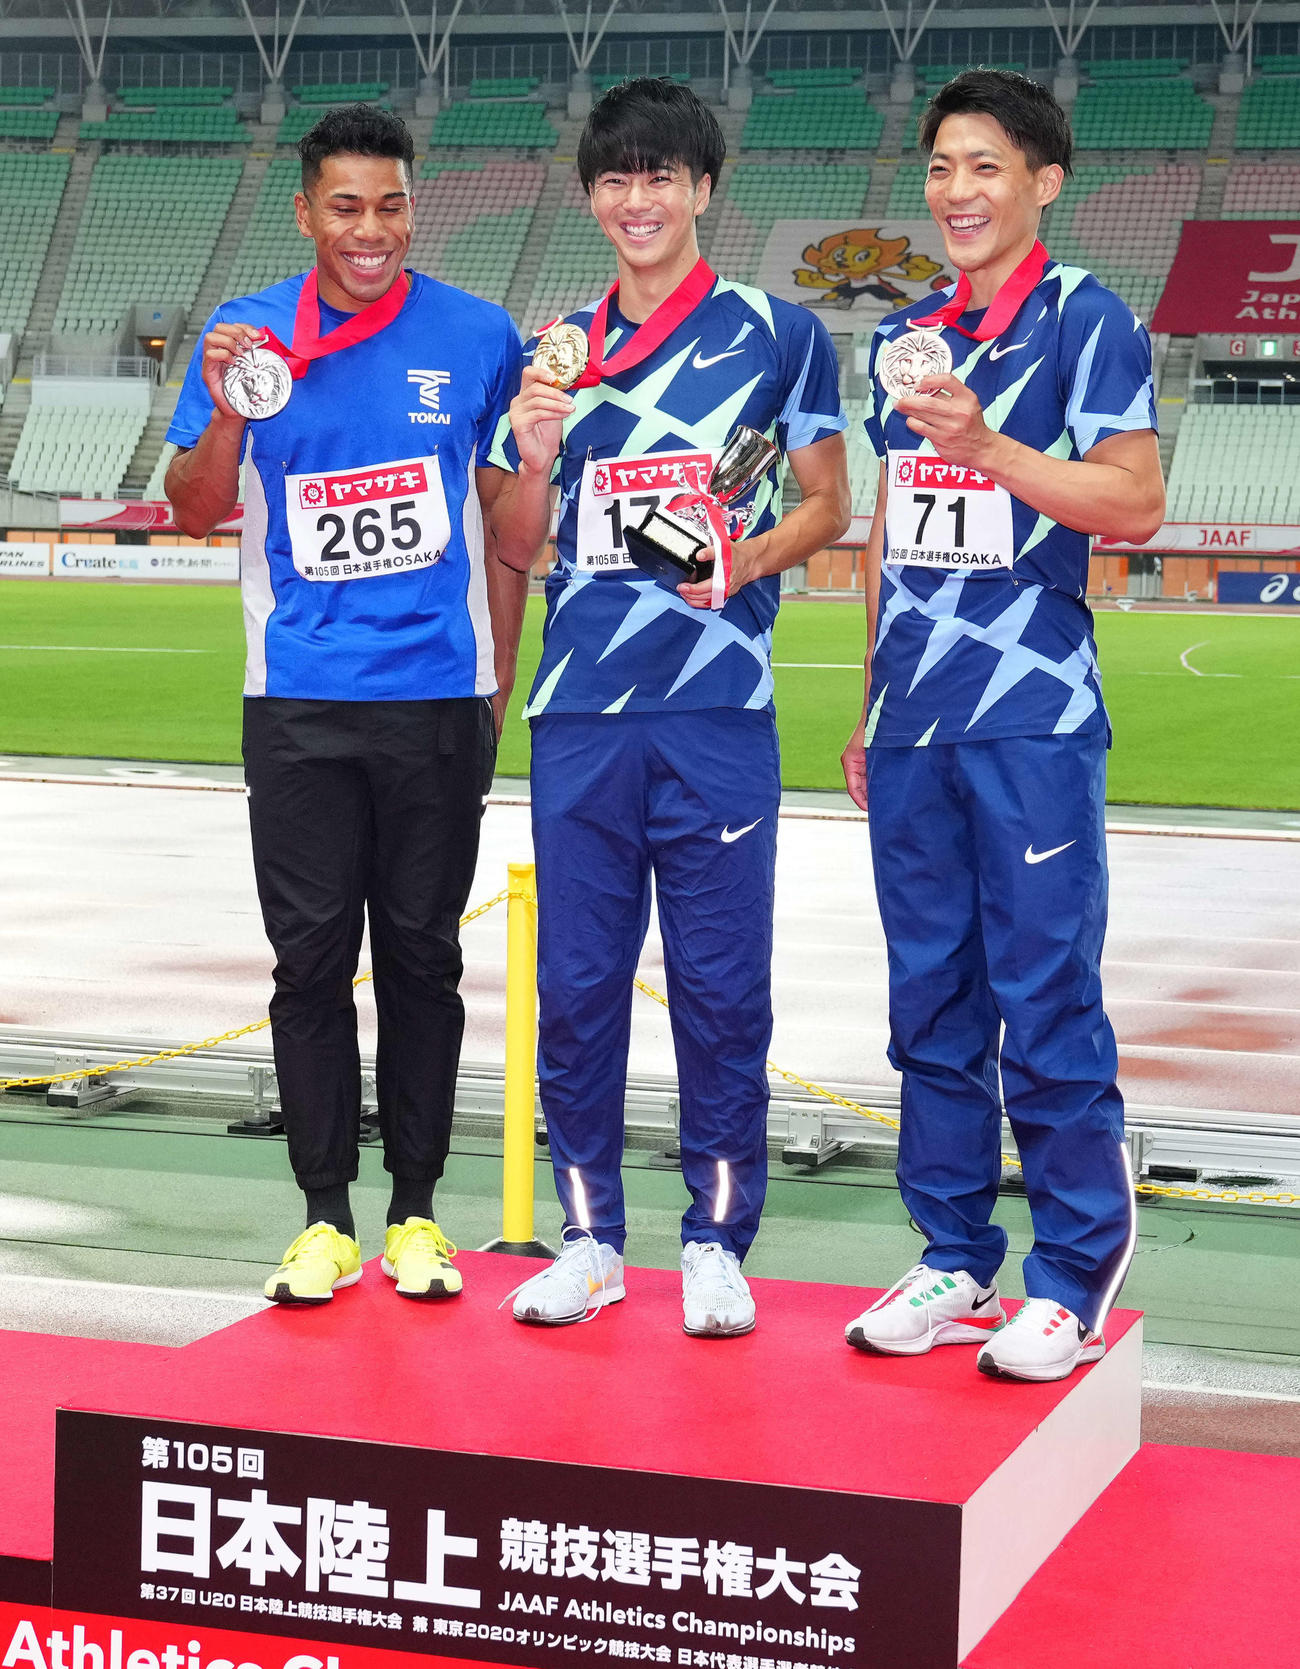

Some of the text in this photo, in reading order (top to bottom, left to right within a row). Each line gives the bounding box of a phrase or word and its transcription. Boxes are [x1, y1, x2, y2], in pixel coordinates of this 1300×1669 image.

[1231, 341, 1244, 355] G
[408, 412, 450, 425] TOKAI
[331, 470, 420, 501] ヤマザキ
[616, 461, 707, 487] ヤマザキ
[316, 500, 422, 562] 265
[604, 493, 688, 549] 17
[913, 494, 966, 548] 71
[1198, 530, 1251, 547] JAAF
[61, 552, 117, 569] Create
[141, 1435, 265, 1480] 第105回
[140, 1481, 861, 1611] 日本陸上 競技選手権大会
[2, 1620, 263, 1669] Athleti
[140, 1583, 196, 1607] 第37回
[199, 1594, 236, 1610] U20
[239, 1596, 402, 1631] 日本陸上競技選手権大会
[412, 1615, 428, 1633] 兼
[432, 1618, 671, 1663] 東京2020オリンピック競技大会
[497, 1591, 856, 1656] JAAF Athletics Championships
